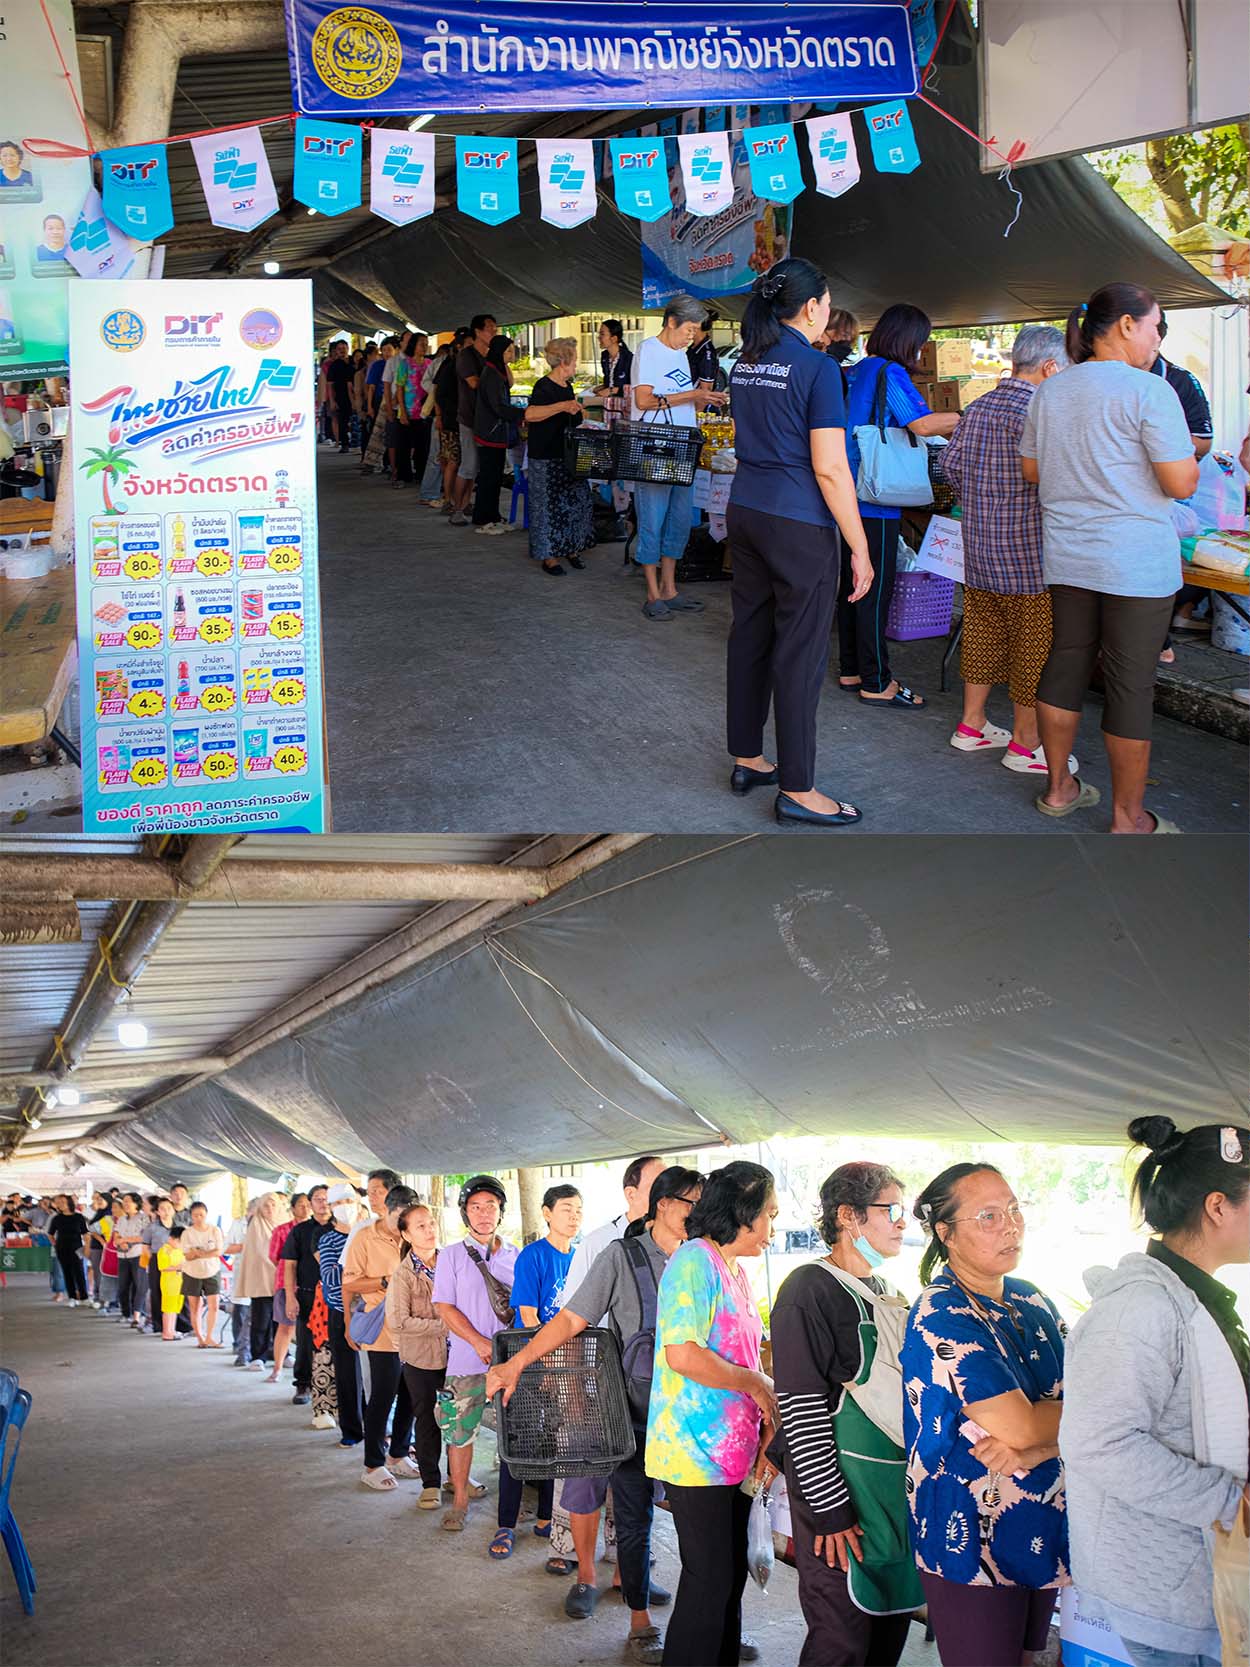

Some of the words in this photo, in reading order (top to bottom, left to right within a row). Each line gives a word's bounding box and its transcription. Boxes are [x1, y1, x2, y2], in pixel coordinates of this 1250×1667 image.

[422, 20, 896, 74] สำนักงานพาณิชย์จังหวัดตราด
[871, 109, 904, 132] DiT
[304, 136, 353, 156] DiT
[752, 135, 789, 157] DiT
[464, 151, 509, 169] DiT
[619, 149, 659, 169] DiT
[111, 159, 158, 181] DiT
[164, 312, 223, 335] DiT
[164, 335, 222, 343] กรมการค้าภายใน
[81, 365, 262, 444] ไทยช่วยไทย
[162, 413, 301, 454] ลดค่าครองชีพ
[123, 472, 268, 497] จังหวัดตราด
[203, 557, 227, 568] 30.-
[275, 553, 297, 564] 20.-
[132, 561, 156, 571] 80.-
[206, 624, 228, 634] 35.-
[277, 620, 297, 631] 15.-
[133, 630, 156, 640] 90.-
[208, 693, 231, 704] 20.-
[279, 686, 301, 697] 45.-
[139, 698, 156, 708] 4.-
[210, 760, 232, 771] 50.-
[281, 754, 302, 764] 40.-
[138, 766, 161, 777] 40.-
[97, 804, 141, 821] ของดี
[145, 801, 203, 818] ราคาถูก
[132, 810, 279, 834] เพื่อพี่น้องชาวจังหวัดตราด
